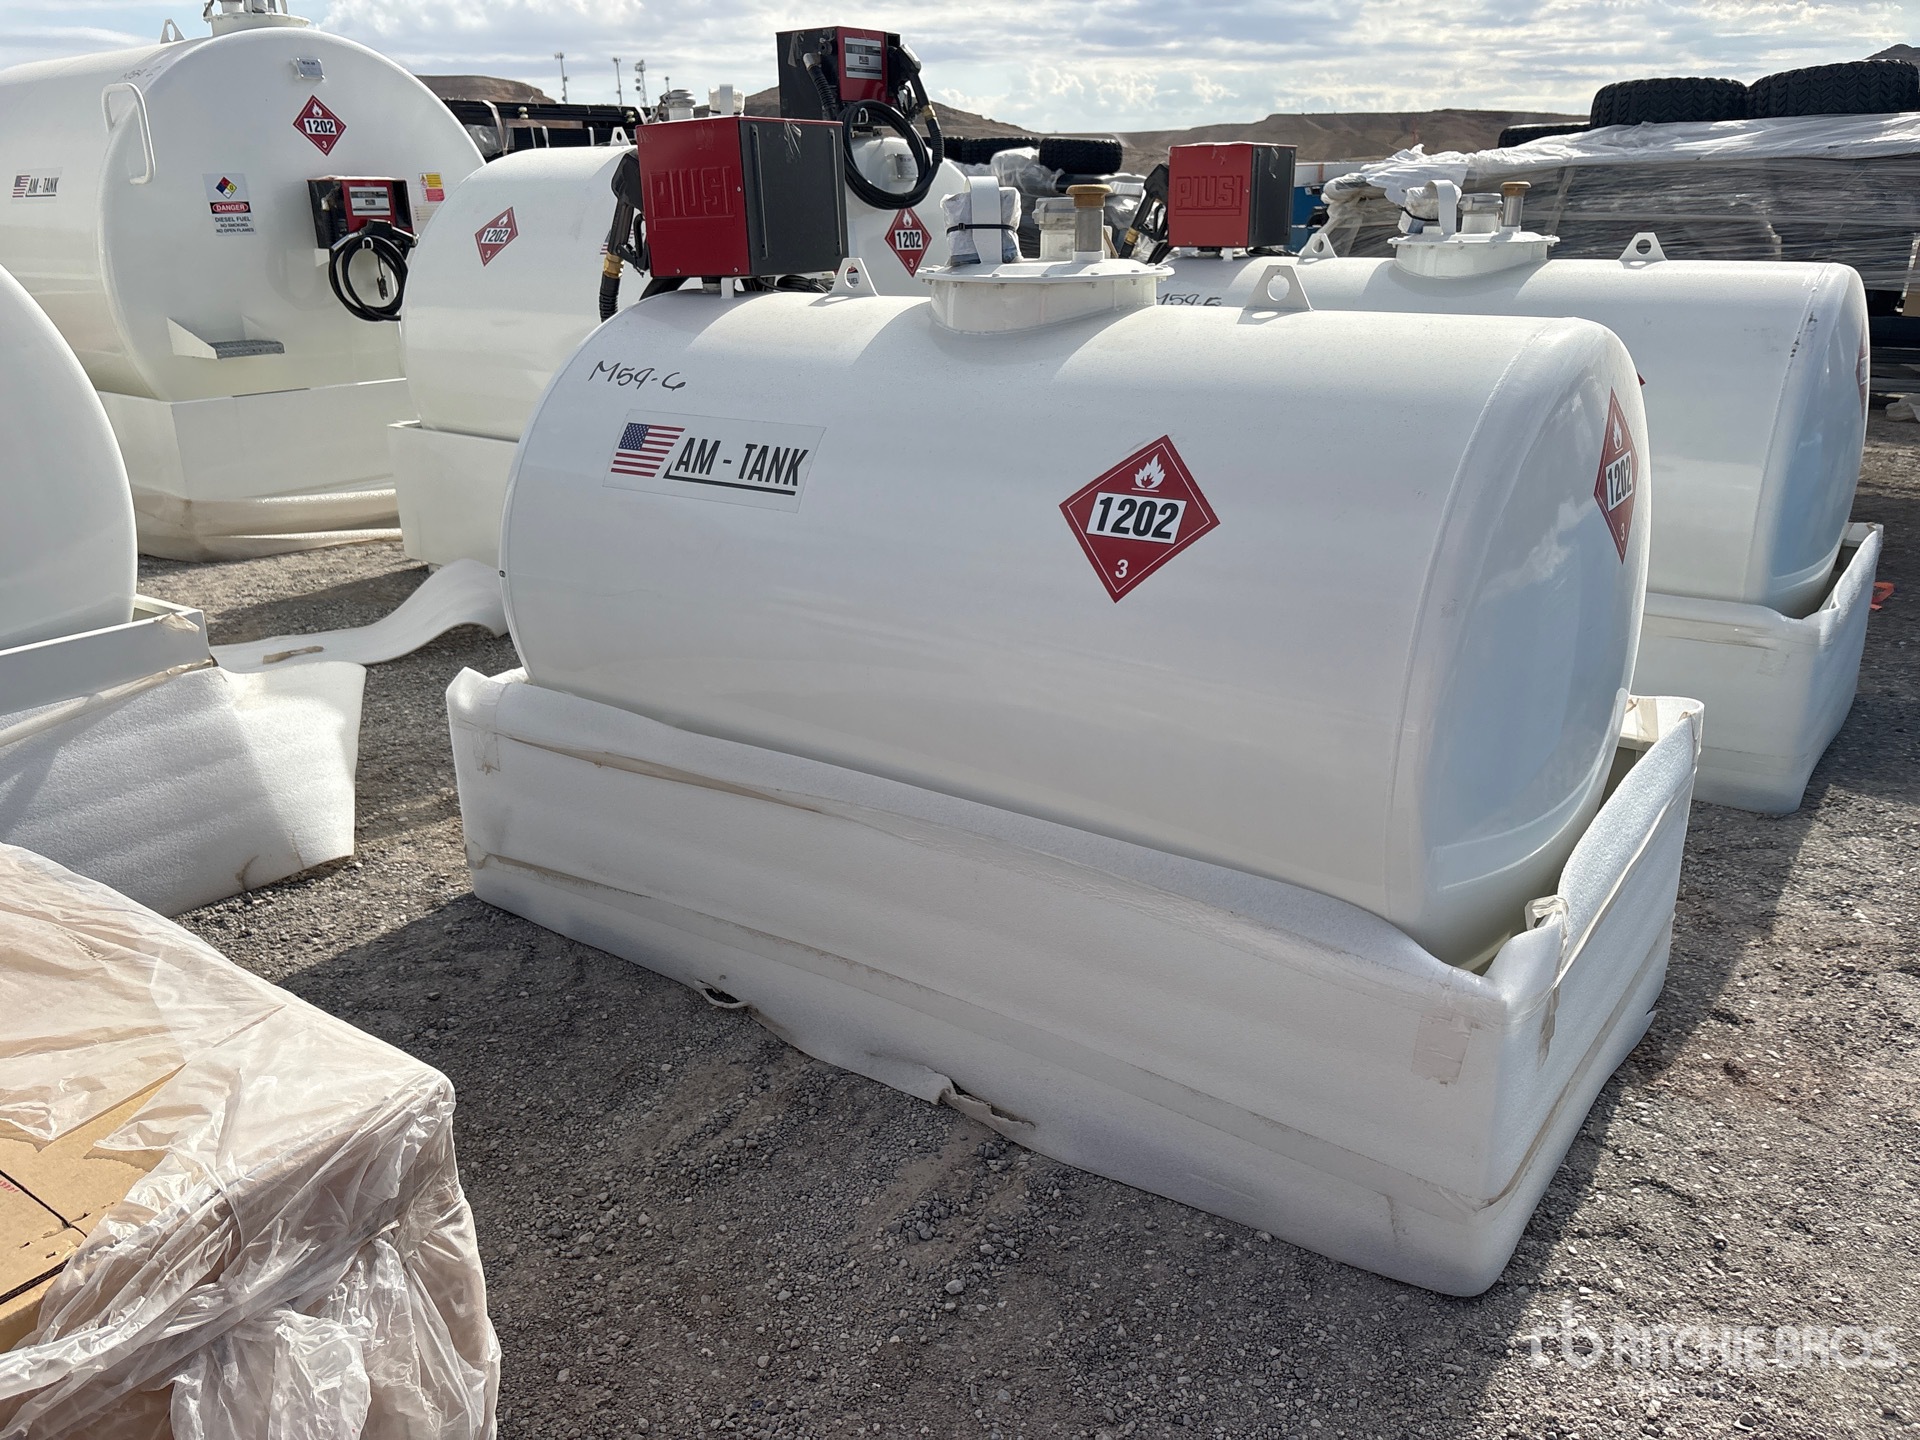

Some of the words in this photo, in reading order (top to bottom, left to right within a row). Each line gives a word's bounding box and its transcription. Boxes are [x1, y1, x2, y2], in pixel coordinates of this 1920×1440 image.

[306, 119, 335, 134] 1202
[321, 140, 328, 149] 3
[650, 166, 735, 218] PIUSI
[1176, 175, 1243, 208] PIUSI
[484, 229, 509, 243] 1202
[896, 231, 922, 249] 1202
[908, 258, 914, 268] 3
[674, 437, 721, 475] AM
[738, 443, 809, 486] TANK
[1607, 455, 1632, 505] 1202
[1096, 496, 1179, 540] 1202
[1619, 522, 1626, 542] 3
[1115, 559, 1129, 579] 3
